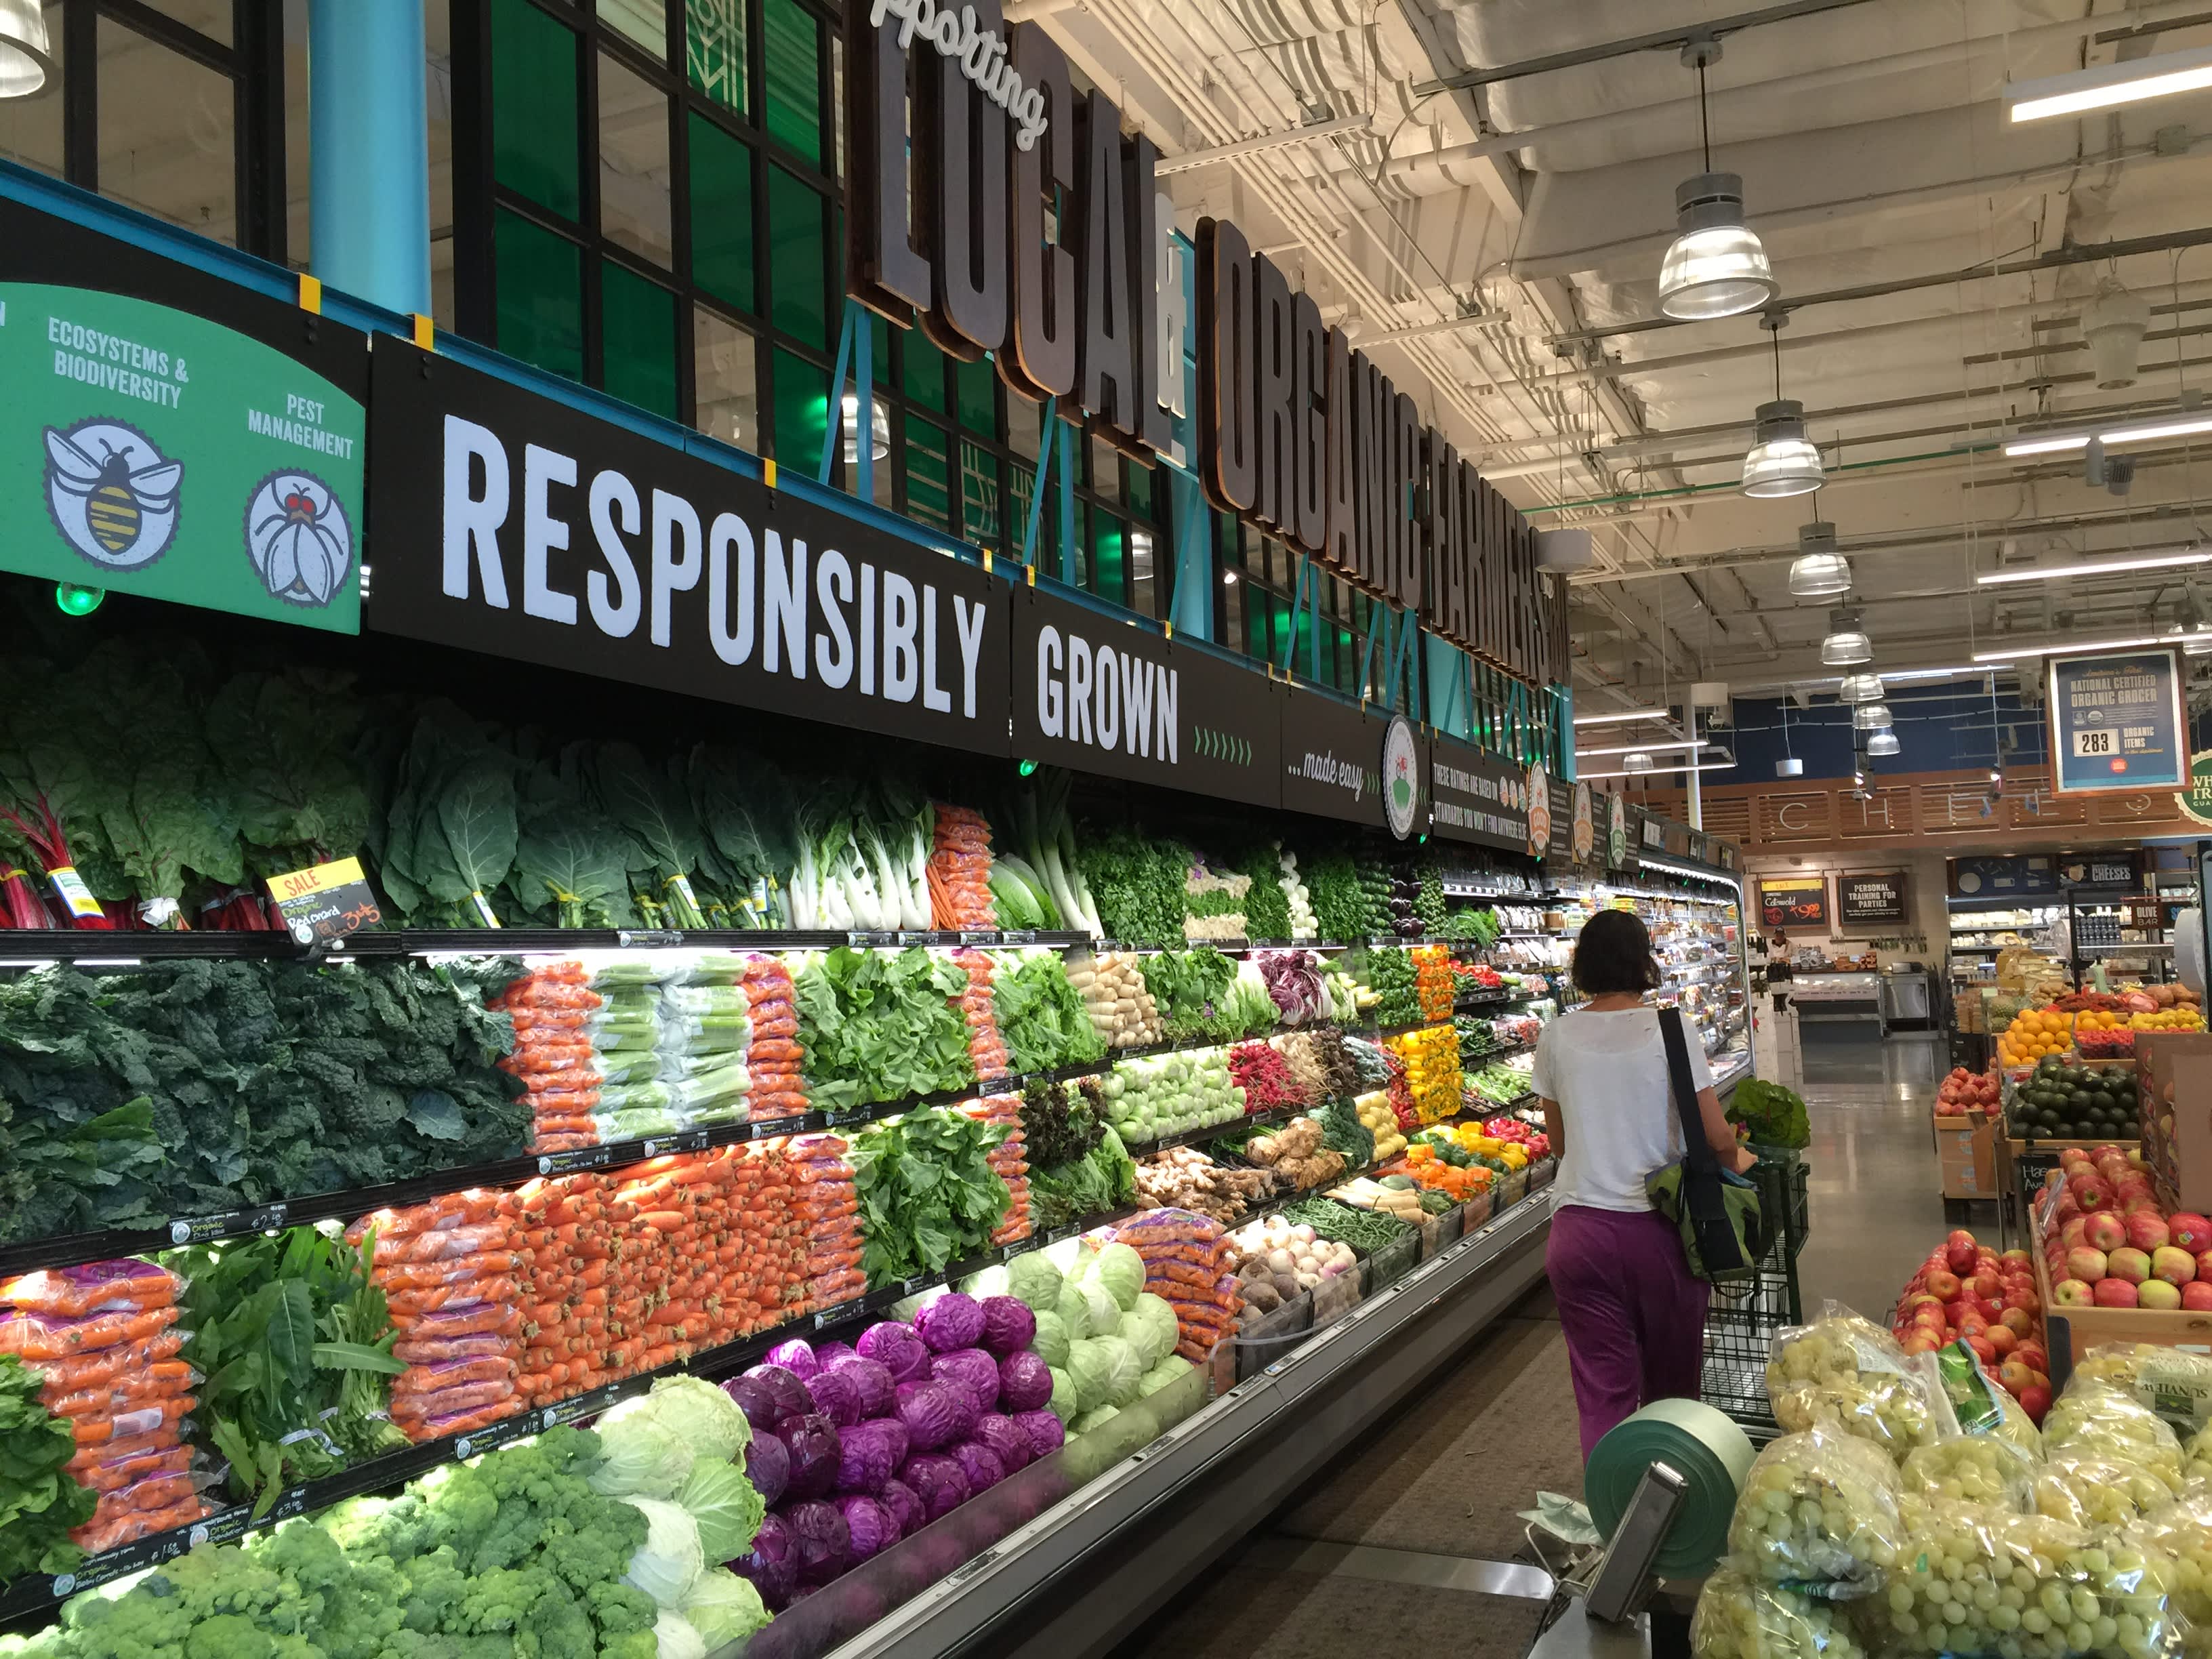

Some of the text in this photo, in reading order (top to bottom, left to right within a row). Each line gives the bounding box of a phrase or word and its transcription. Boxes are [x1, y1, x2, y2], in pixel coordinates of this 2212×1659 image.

[874, 0, 1172, 456] LOCAL
[48, 316, 190, 383] ECOSYSTEMS &
[54, 350, 182, 409] BIODIVERSITY
[287, 393, 325, 425] PEST
[1216, 218, 1421, 609] ORGANIC
[247, 409, 354, 460] MANAGEMENT
[443, 414, 986, 718] RESPONSIBLY
[2070, 674, 2156, 693] NATIONAL CERTIFIED
[1038, 625, 1178, 764] GROWN
[2071, 688, 2158, 708] ORGANIC GROCER
[2123, 726, 2154, 738] ORGANIC
[2082, 733, 2109, 753] 283
[2124, 738, 2146, 749] ITEMS
[1338, 762, 1364, 802] easy
[1433, 762, 1450, 787] THESE
[283, 869, 321, 897] SALE
[2092, 866, 2131, 882] CHEESES
[1848, 890, 1896, 900] TRAINING FOR
[1853, 883, 1889, 893] PERSONAL
[1858, 899, 1887, 909] PARTIES
[2137, 905, 2158, 918] OLIVE
[2137, 917, 2158, 927] BAR
[192, 1221, 224, 1233] Organic
